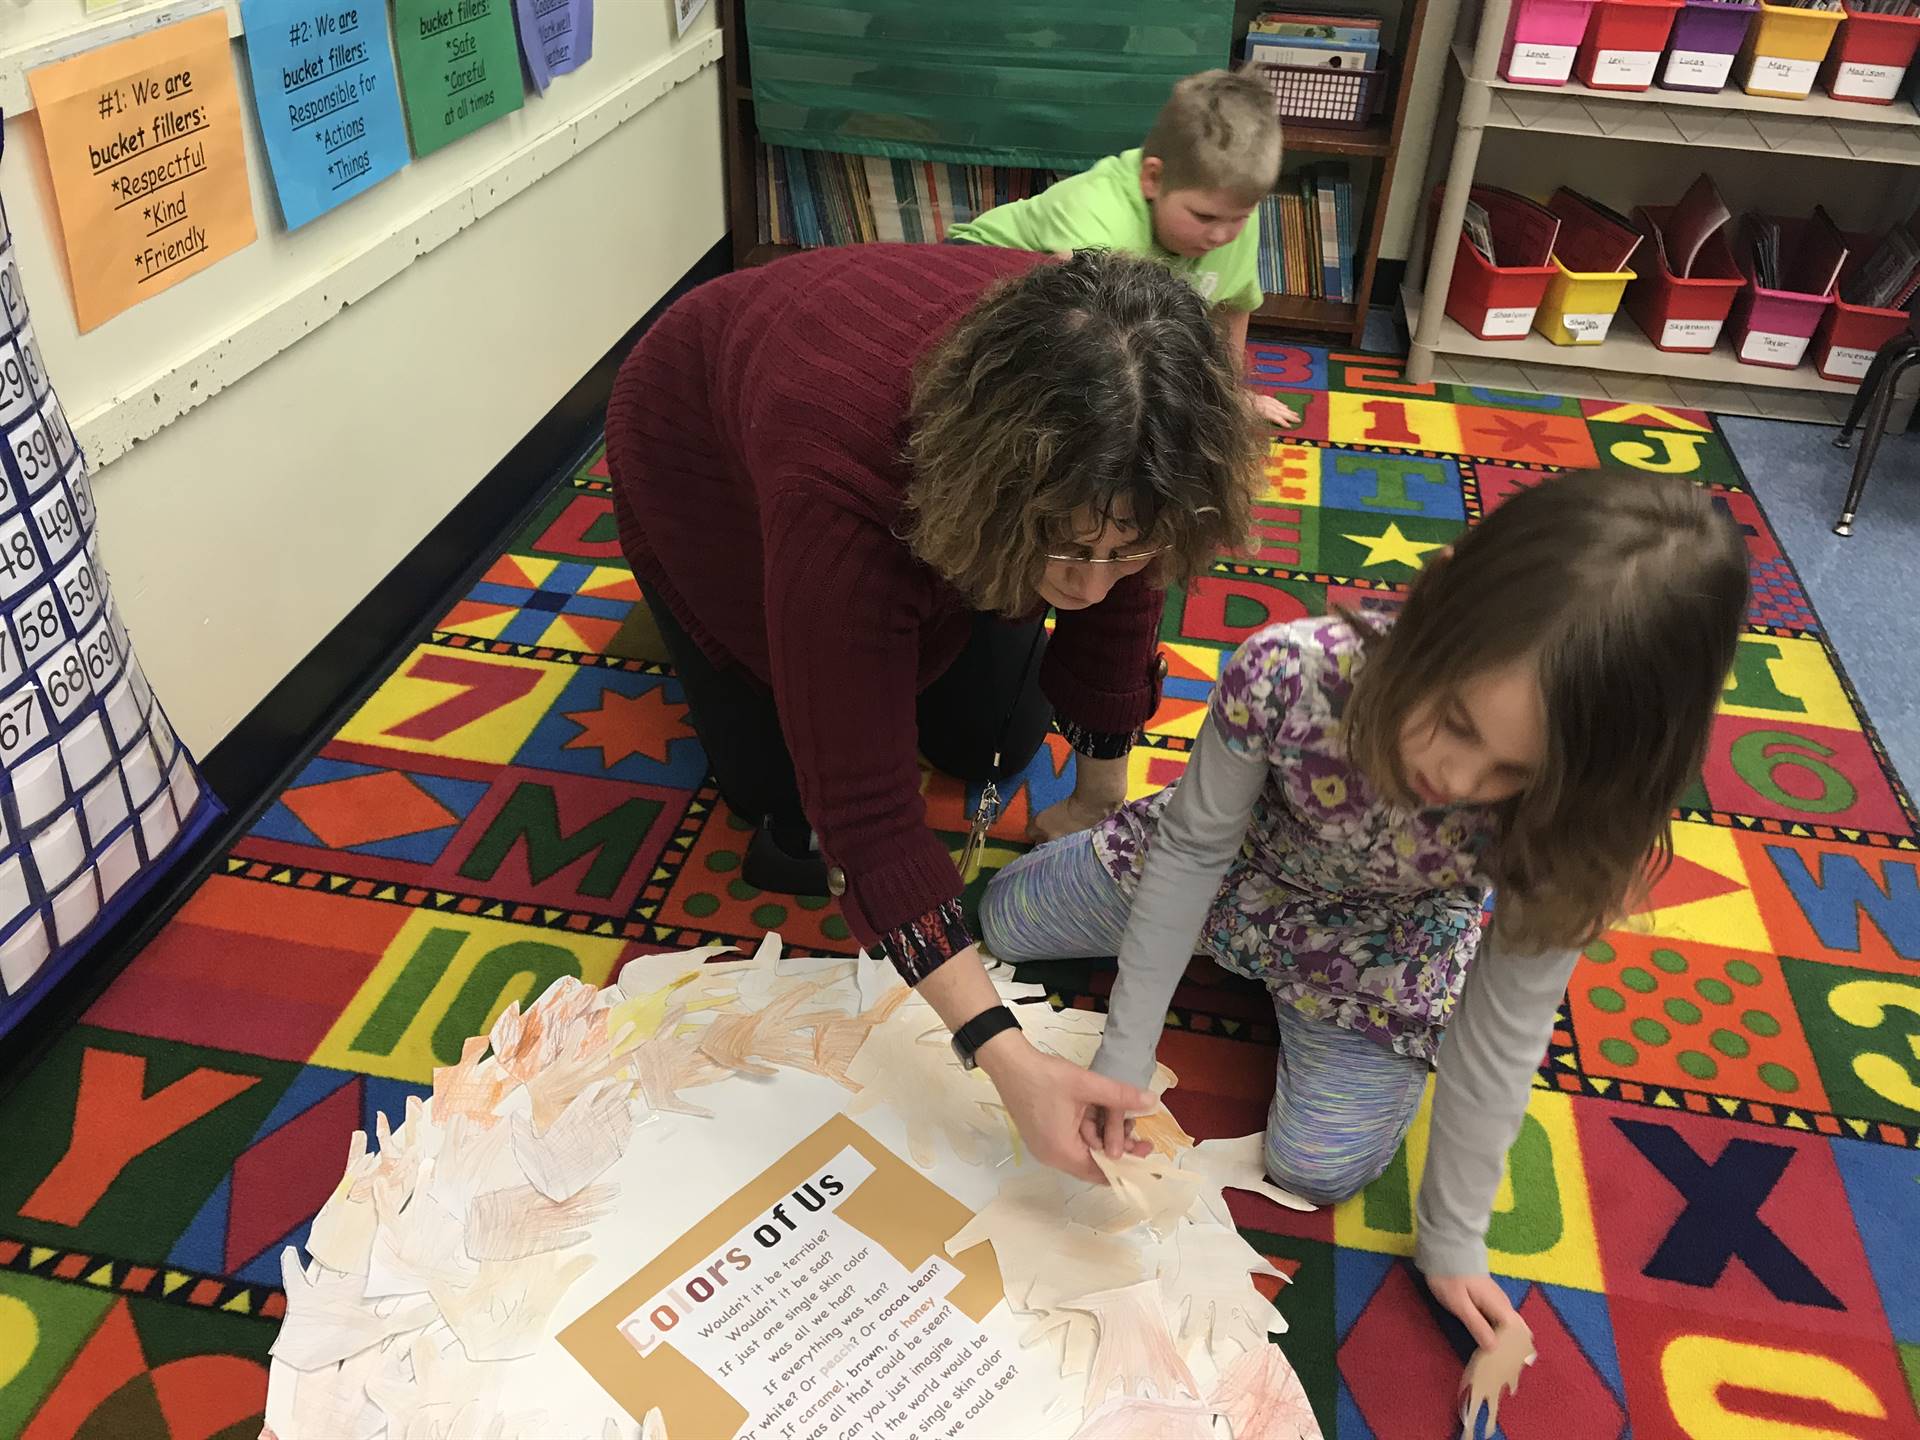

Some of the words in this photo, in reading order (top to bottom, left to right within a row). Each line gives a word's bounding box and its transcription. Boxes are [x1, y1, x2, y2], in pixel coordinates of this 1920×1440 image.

[289, 21, 313, 47] #2:
[316, 12, 336, 38] We
[339, 9, 358, 32] are
[420, 8, 454, 36] bucket
[283, 56, 324, 91] bucket
[328, 41, 368, 73] fillers:
[1679, 57, 1705, 67] Lucas
[1767, 61, 1793, 72] Mary
[98, 88, 128, 120] #1:
[131, 78, 161, 106] We
[165, 71, 192, 97] are
[289, 80, 358, 128] Responsible
[359, 73, 377, 98] for
[444, 106, 455, 126] at
[457, 96, 469, 120] all
[470, 90, 495, 113] times
[88, 126, 145, 170] bucket
[152, 106, 208, 144] fillers:
[1245, 342, 1313, 384] B
[1763, 336, 1790, 348] Taylor
[1362, 400, 1421, 445] 1
[1610, 429, 1708, 474] J
[17, 429, 51, 480] 39
[1335, 454, 1446, 511] T
[39, 498, 73, 543] 49
[64, 566, 95, 617] 59
[1178, 576, 1310, 644] D
[19, 600, 59, 651] 58
[87, 630, 114, 679] 69
[48, 655, 84, 707] 68
[379, 652, 547, 743] 7
[0, 694, 34, 751] 67
[1729, 729, 1858, 814] 6
[456, 780, 668, 900] M
[17, 1046, 262, 1228] Y
[1609, 1116, 1848, 1313] X
[621, 1247, 752, 1351] Colors
[753, 1203, 798, 1248] of
[791, 1174, 844, 1212] Us
[697, 1294, 752, 1339] Wouldn't
[750, 1283, 765, 1297] it
[764, 1270, 783, 1285] be
[782, 1229, 830, 1270] terrible?
[717, 1360, 735, 1378] If
[734, 1339, 761, 1366] just
[762, 1320, 785, 1341] one
[784, 1292, 819, 1322] single
[818, 1271, 843, 1293] skin
[843, 1246, 870, 1273] color
[725, 1297, 779, 1342] Wouldn't
[777, 1286, 792, 1299] it
[791, 1275, 809, 1289] be
[809, 1250, 835, 1275] sad?
[767, 1341, 793, 1364] was
[794, 1324, 811, 1342] all
[811, 1309, 830, 1327] we
[828, 1284, 857, 1310] had?
[758, 1391, 799, 1430] white?
[799, 1375, 818, 1392] Or
[819, 1336, 861, 1378] peach?
[860, 1320, 877, 1338] Or
[878, 1293, 911, 1322] cocoa
[907, 1263, 941, 1294] bean?
[762, 1378, 779, 1396] If
[780, 1327, 844, 1382] everything
[840, 1306, 865, 1327] was
[863, 1281, 890, 1306] tan?
[780, 1422, 797, 1439] If
[798, 1379, 850, 1425] caramel,
[846, 1344, 889, 1378] brown,
[887, 1328, 901, 1343] or
[899, 1297, 937, 1329] honey
[829, 1404, 847, 1422] all
[846, 1378, 875, 1405] that
[875, 1349, 907, 1380] could
[904, 1335, 922, 1351] be
[922, 1304, 953, 1336] seen?
[863, 1400, 887, 1423] you
[885, 1375, 911, 1402] just
[908, 1336, 954, 1377] imagine
[884, 1410, 909, 1432] the
[907, 1377, 941, 1411] world
[939, 1347, 973, 1380] would
[970, 1333, 989, 1351] be
[918, 1399, 953, 1433] single
[952, 1376, 977, 1400] skin
[976, 1348, 1004, 1377] color
[945, 1420, 965, 1438] we
[964, 1389, 995, 1420] could
[993, 1363, 1020, 1391] see?
